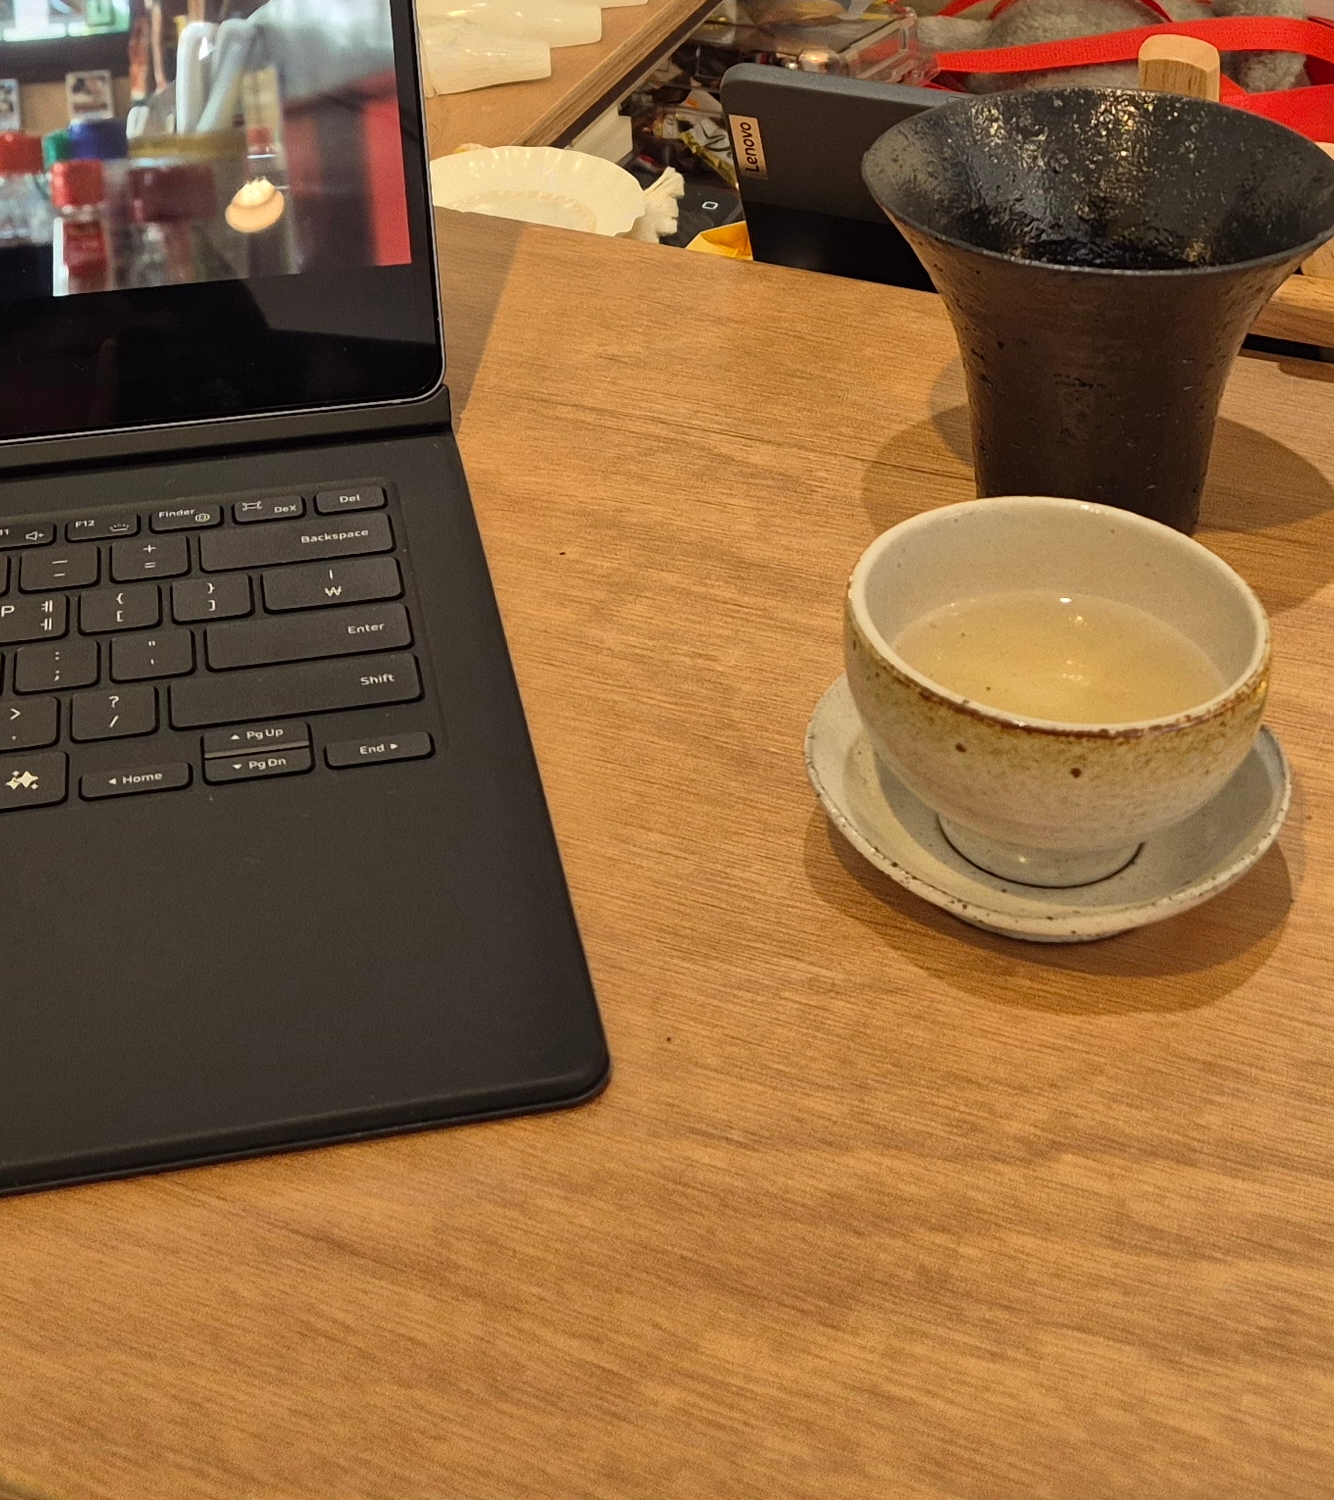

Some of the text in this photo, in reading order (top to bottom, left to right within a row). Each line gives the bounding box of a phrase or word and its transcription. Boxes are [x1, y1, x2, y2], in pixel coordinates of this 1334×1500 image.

[740, 121, 760, 173] Lenovo
[339, 494, 360, 503] Del
[157, 507, 196, 520] Finder
[274, 504, 296, 512] DeX
[75, 519, 94, 527] F12
[300, 529, 368, 543] Backspace
[0, 605, 14, 617] P
[41, 599, 52, 612] ㅖ
[40, 617, 51, 630] ㅔ
[347, 623, 384, 633] Enter
[360, 673, 394, 685] Shift
[108, 695, 119, 707] ?
[359, 743, 384, 754] End
[122, 772, 163, 785] Home
